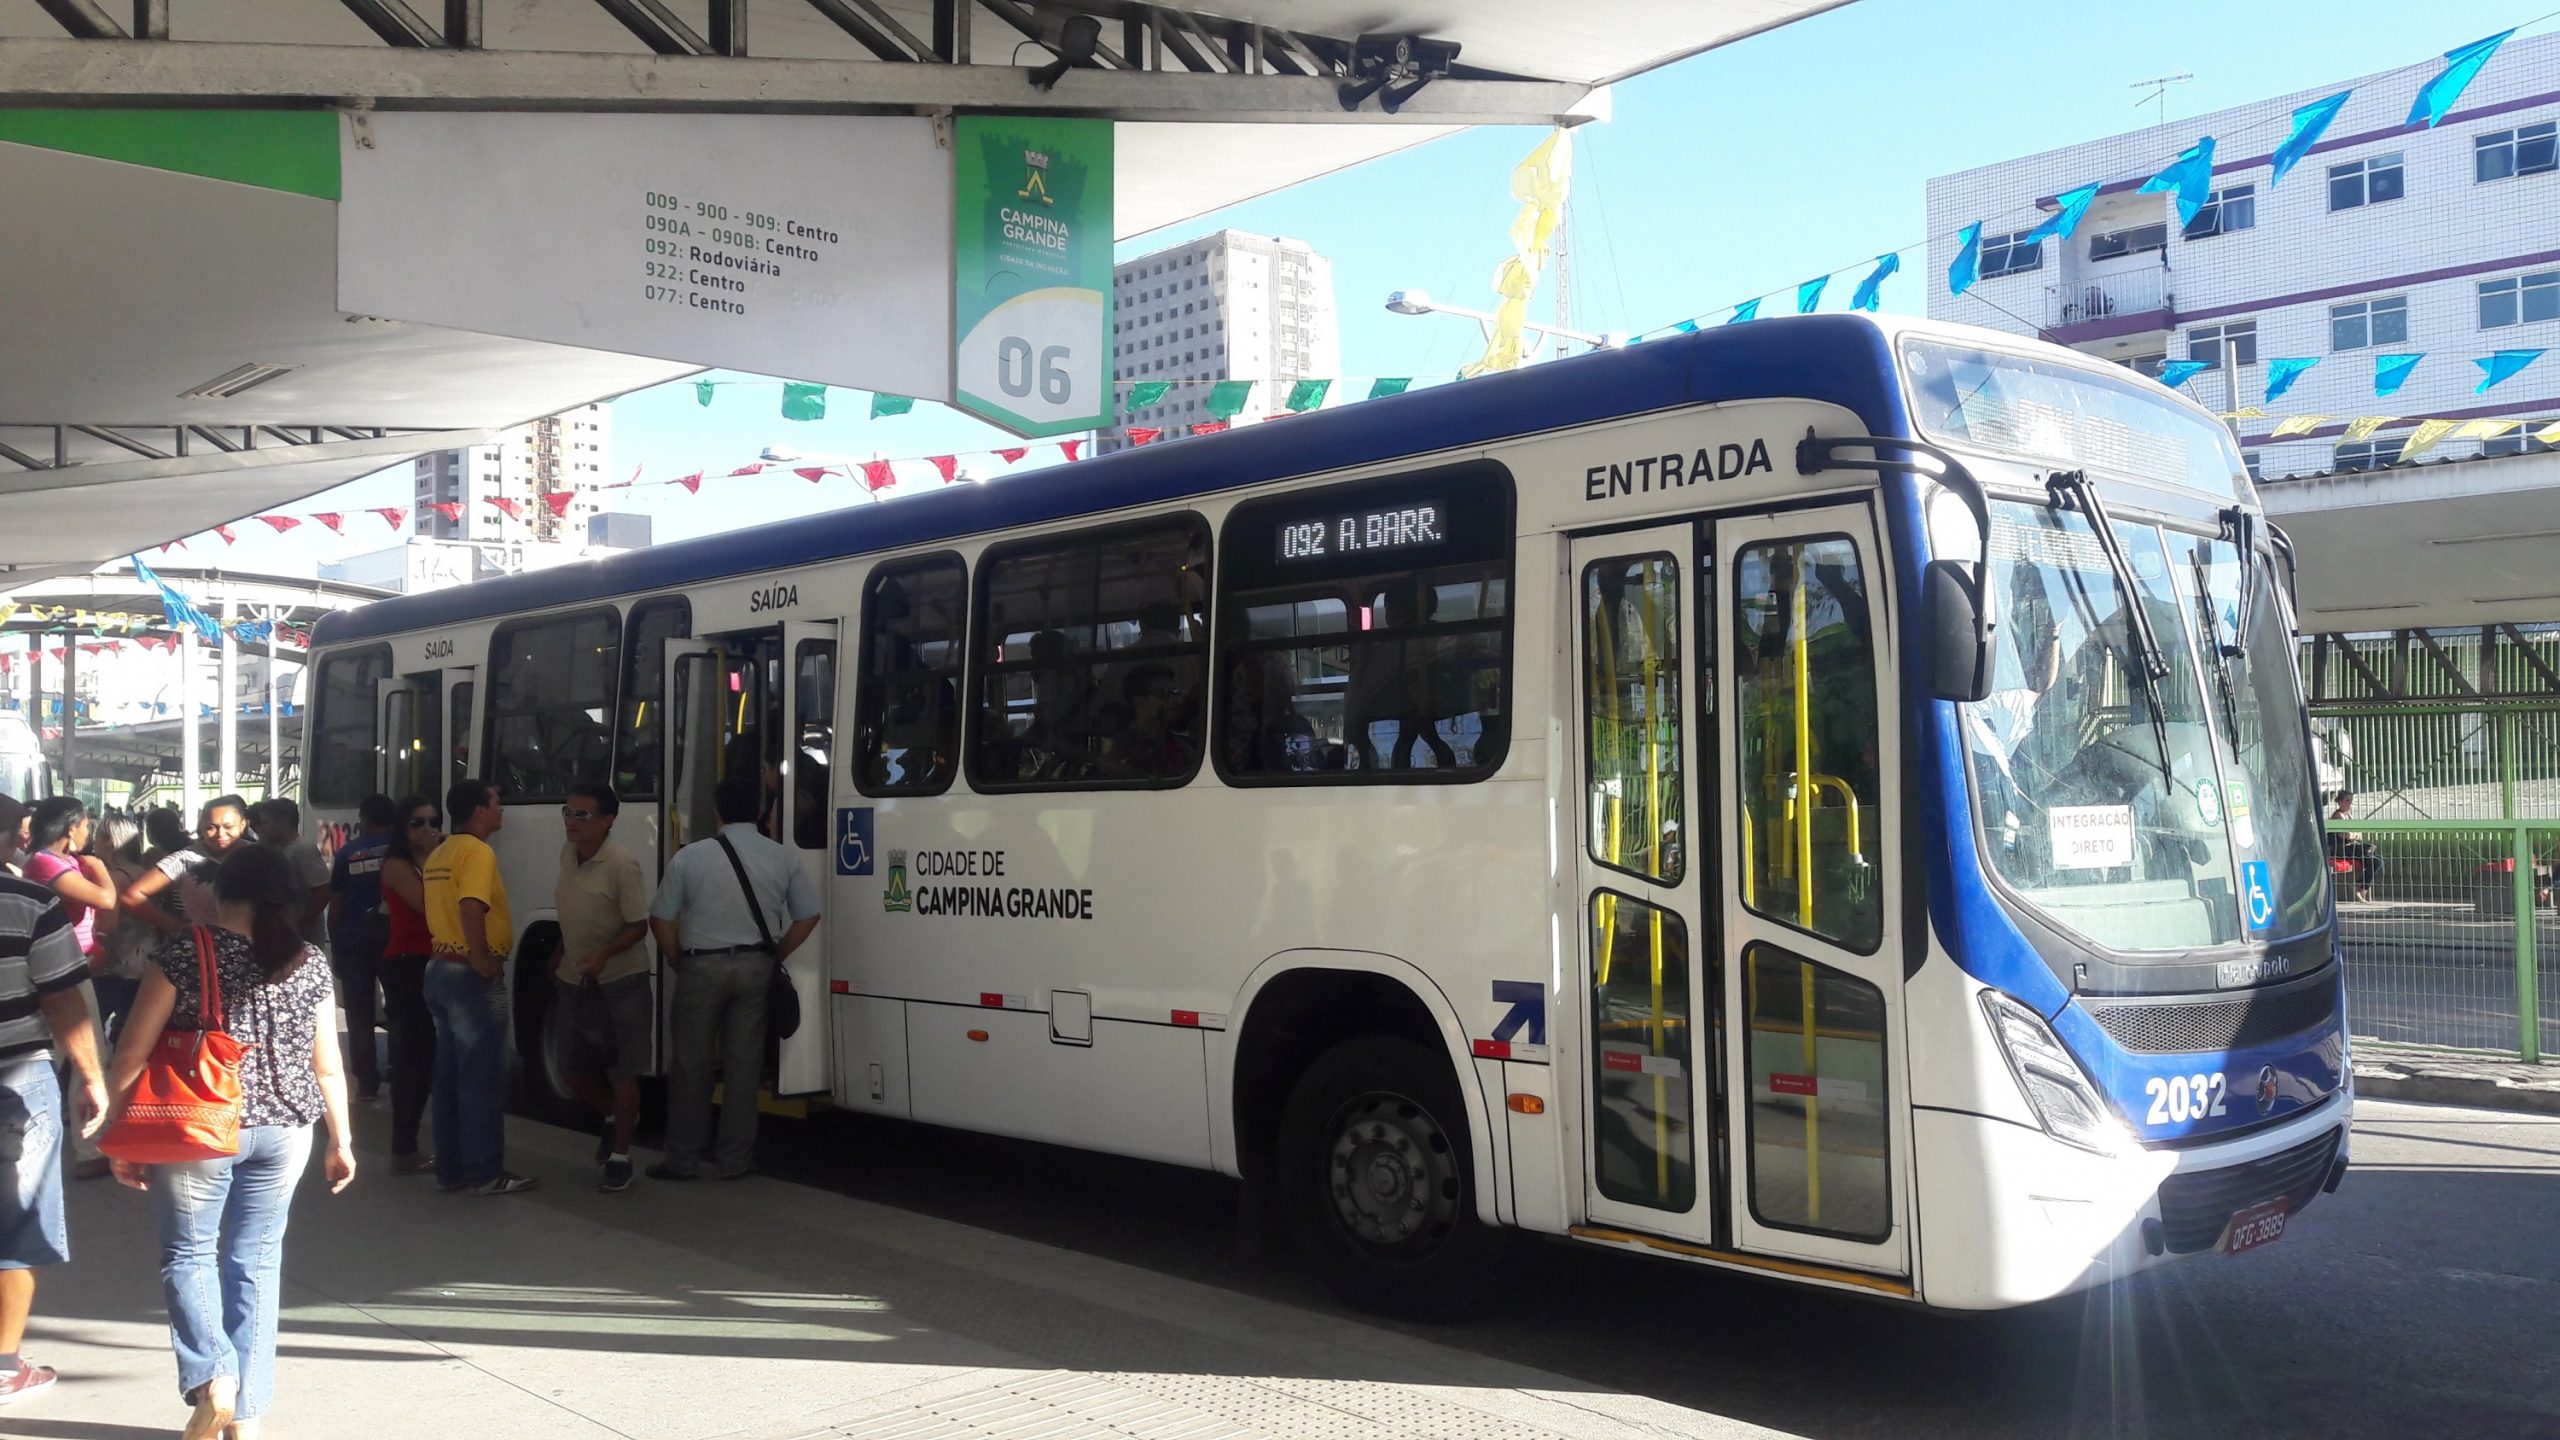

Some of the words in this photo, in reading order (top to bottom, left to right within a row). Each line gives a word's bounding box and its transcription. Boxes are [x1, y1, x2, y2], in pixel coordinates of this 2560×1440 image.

[646, 192, 678, 211] 009
[696, 202, 728, 221] 900
[745, 212, 781, 232] 909:
[786, 220, 839, 244] Centro
[1000, 208, 1069, 237] CAMPINA
[645, 215, 691, 237] 090A
[712, 228, 760, 250] 090B:
[765, 238, 819, 262] Centro
[1003, 224, 1067, 251] GRANDE
[645, 238, 683, 258] 092:
[690, 246, 781, 277] Rodoviária
[645, 262, 683, 281] 922:
[689, 269, 745, 293] Centro
[645, 285, 683, 304] 077:
[689, 292, 745, 315] Centro
[998, 335, 1072, 405] 06
[1585, 438, 1773, 501] ENTRADA
[1284, 522, 1325, 558] 092
[750, 580, 798, 613] SAÍDA
[424, 635, 454, 661] SAÍDA
[916, 851, 977, 876] CIDADE
[982, 851, 1005, 876] DE
[2071, 839, 2114, 855] DIRETO
[916, 885, 1005, 917] CAMPINA
[1006, 888, 1093, 920] GRANDE
[2145, 1072, 2227, 1126] 2032
